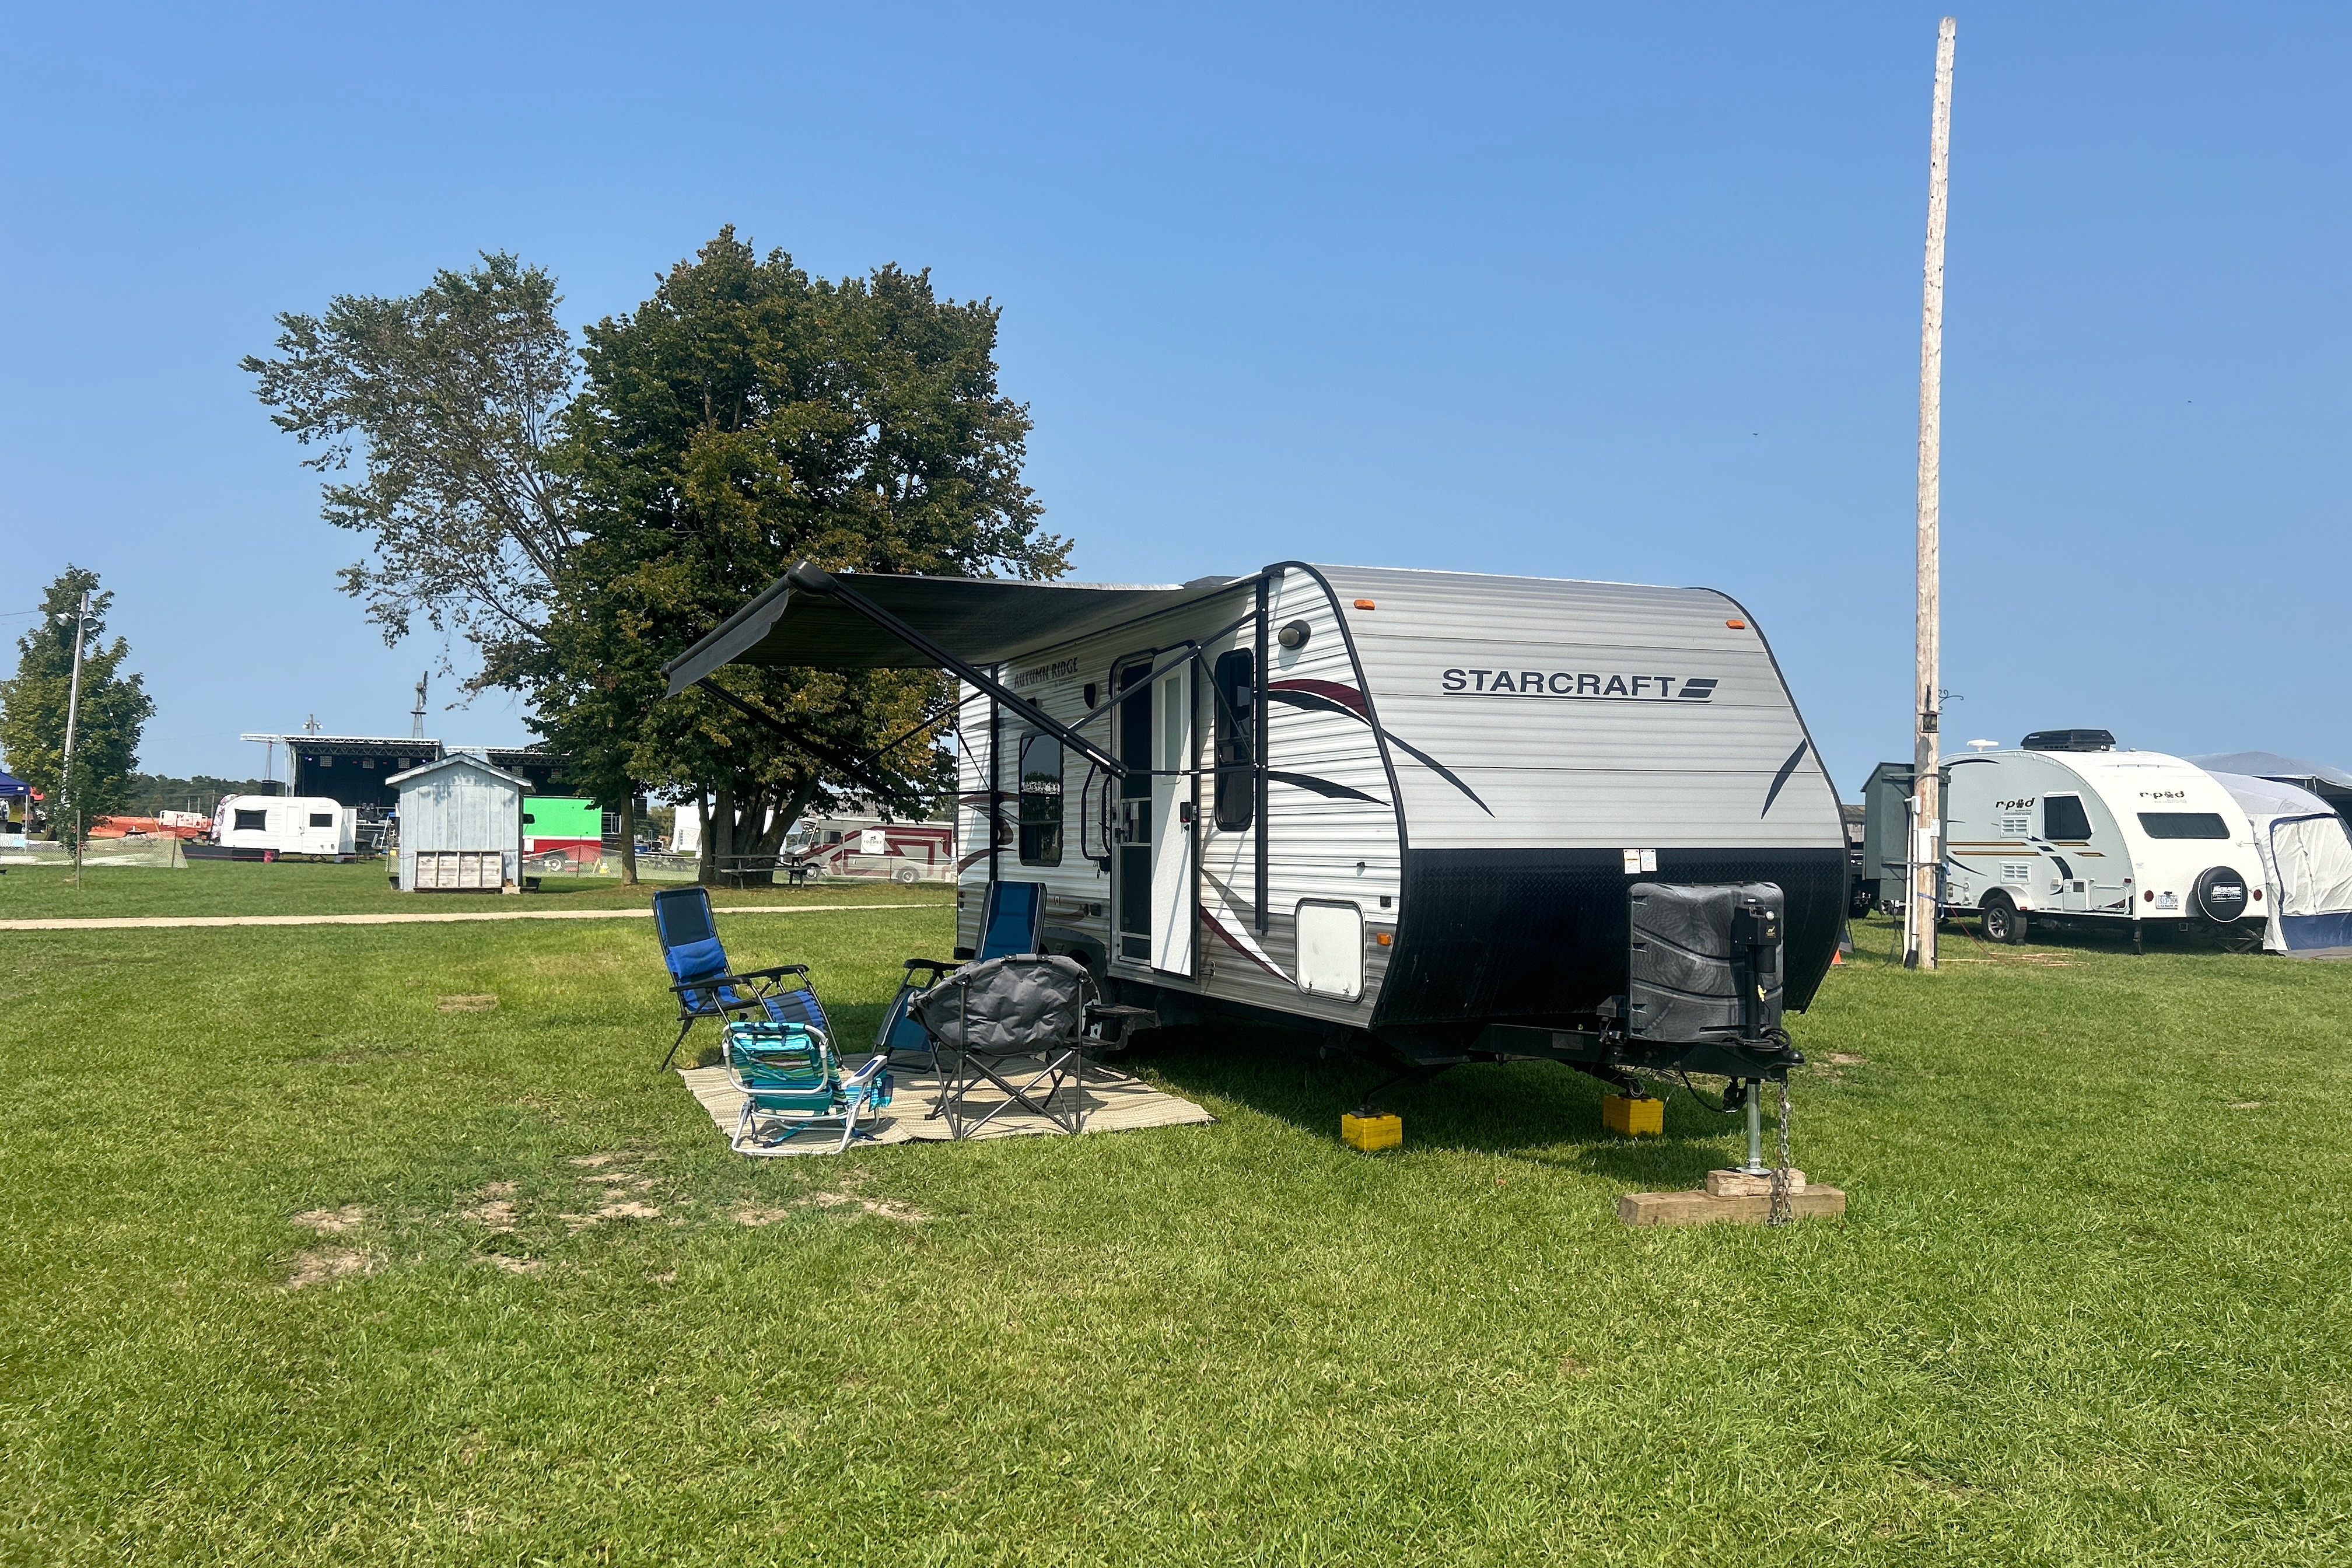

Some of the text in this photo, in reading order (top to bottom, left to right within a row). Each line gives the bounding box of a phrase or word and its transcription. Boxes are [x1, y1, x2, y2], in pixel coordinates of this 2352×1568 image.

[1014, 666, 1049, 689] AUTUMN
[1051, 657, 1078, 678] RIDGE
[1441, 668, 1676, 697] STARCRAFT
